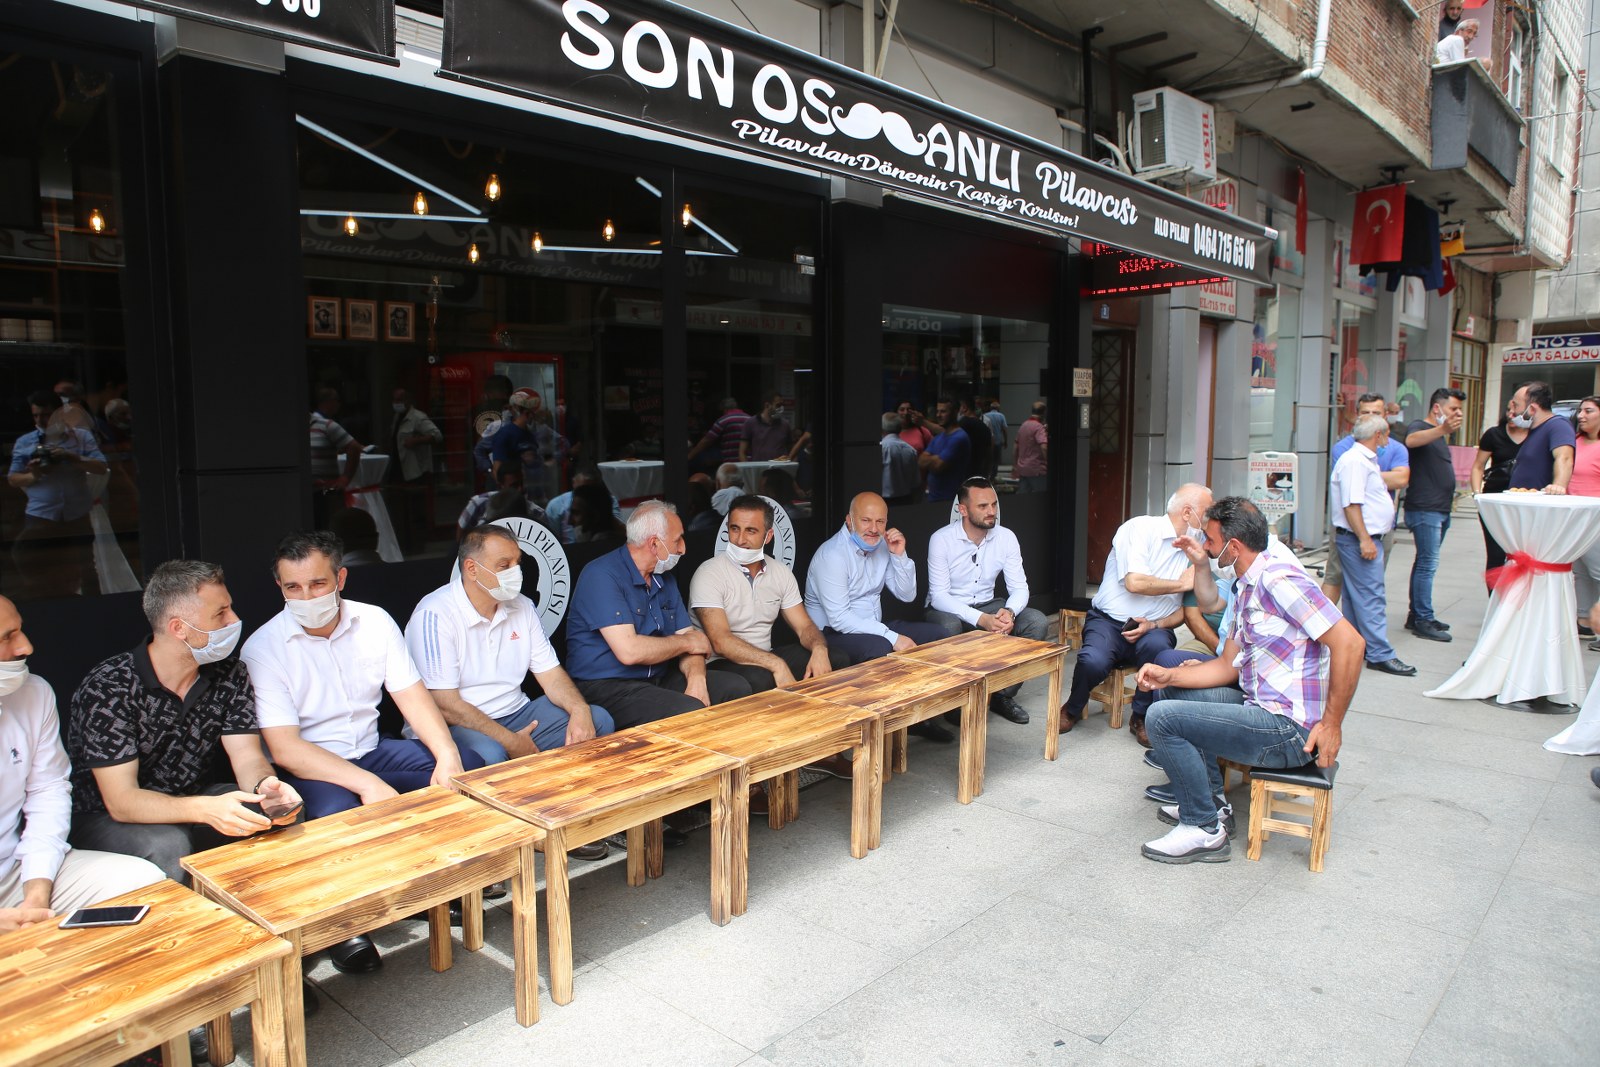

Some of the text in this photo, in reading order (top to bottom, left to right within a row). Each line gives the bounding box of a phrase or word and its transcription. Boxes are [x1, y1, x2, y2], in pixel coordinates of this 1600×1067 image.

[561, 0, 734, 109] SON
[731, 119, 857, 167] Pilavdan
[857, 153, 948, 191] Dönenin
[1154, 216, 1169, 238] ALO
[1194, 222, 1217, 259] 0464
[1218, 230, 1232, 264] 715
[1233, 235, 1244, 268] 65
[1244, 239, 1256, 270] 00
[1545, 348, 1600, 361] SALONU
